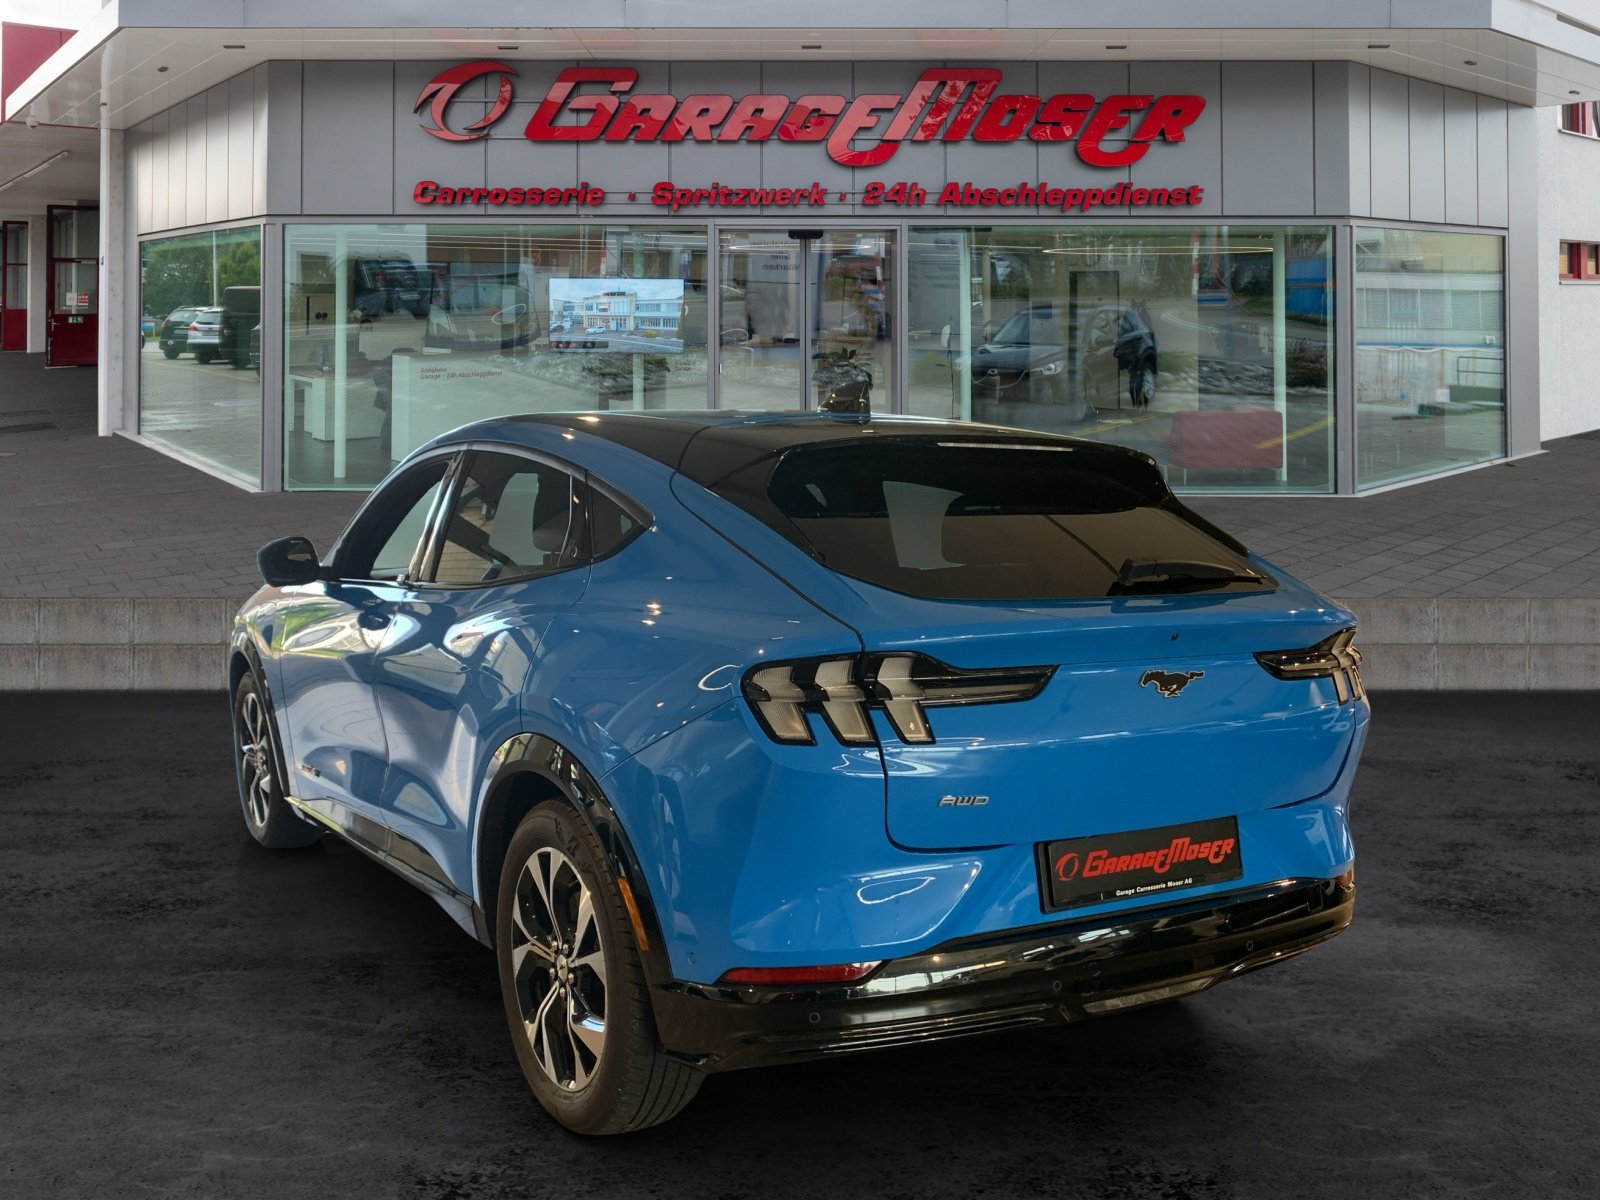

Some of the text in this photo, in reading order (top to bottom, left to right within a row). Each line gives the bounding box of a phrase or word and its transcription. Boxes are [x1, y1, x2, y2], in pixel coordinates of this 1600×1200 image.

[413, 181, 1204, 211] Carrosserie Spritzwerk 24h Abschleppdienst
[937, 794, 990, 808] AWD
[1116, 889, 1135, 897] Garage
[1136, 883, 1166, 893] Carrosserie
[1167, 880, 1184, 888] Moser
